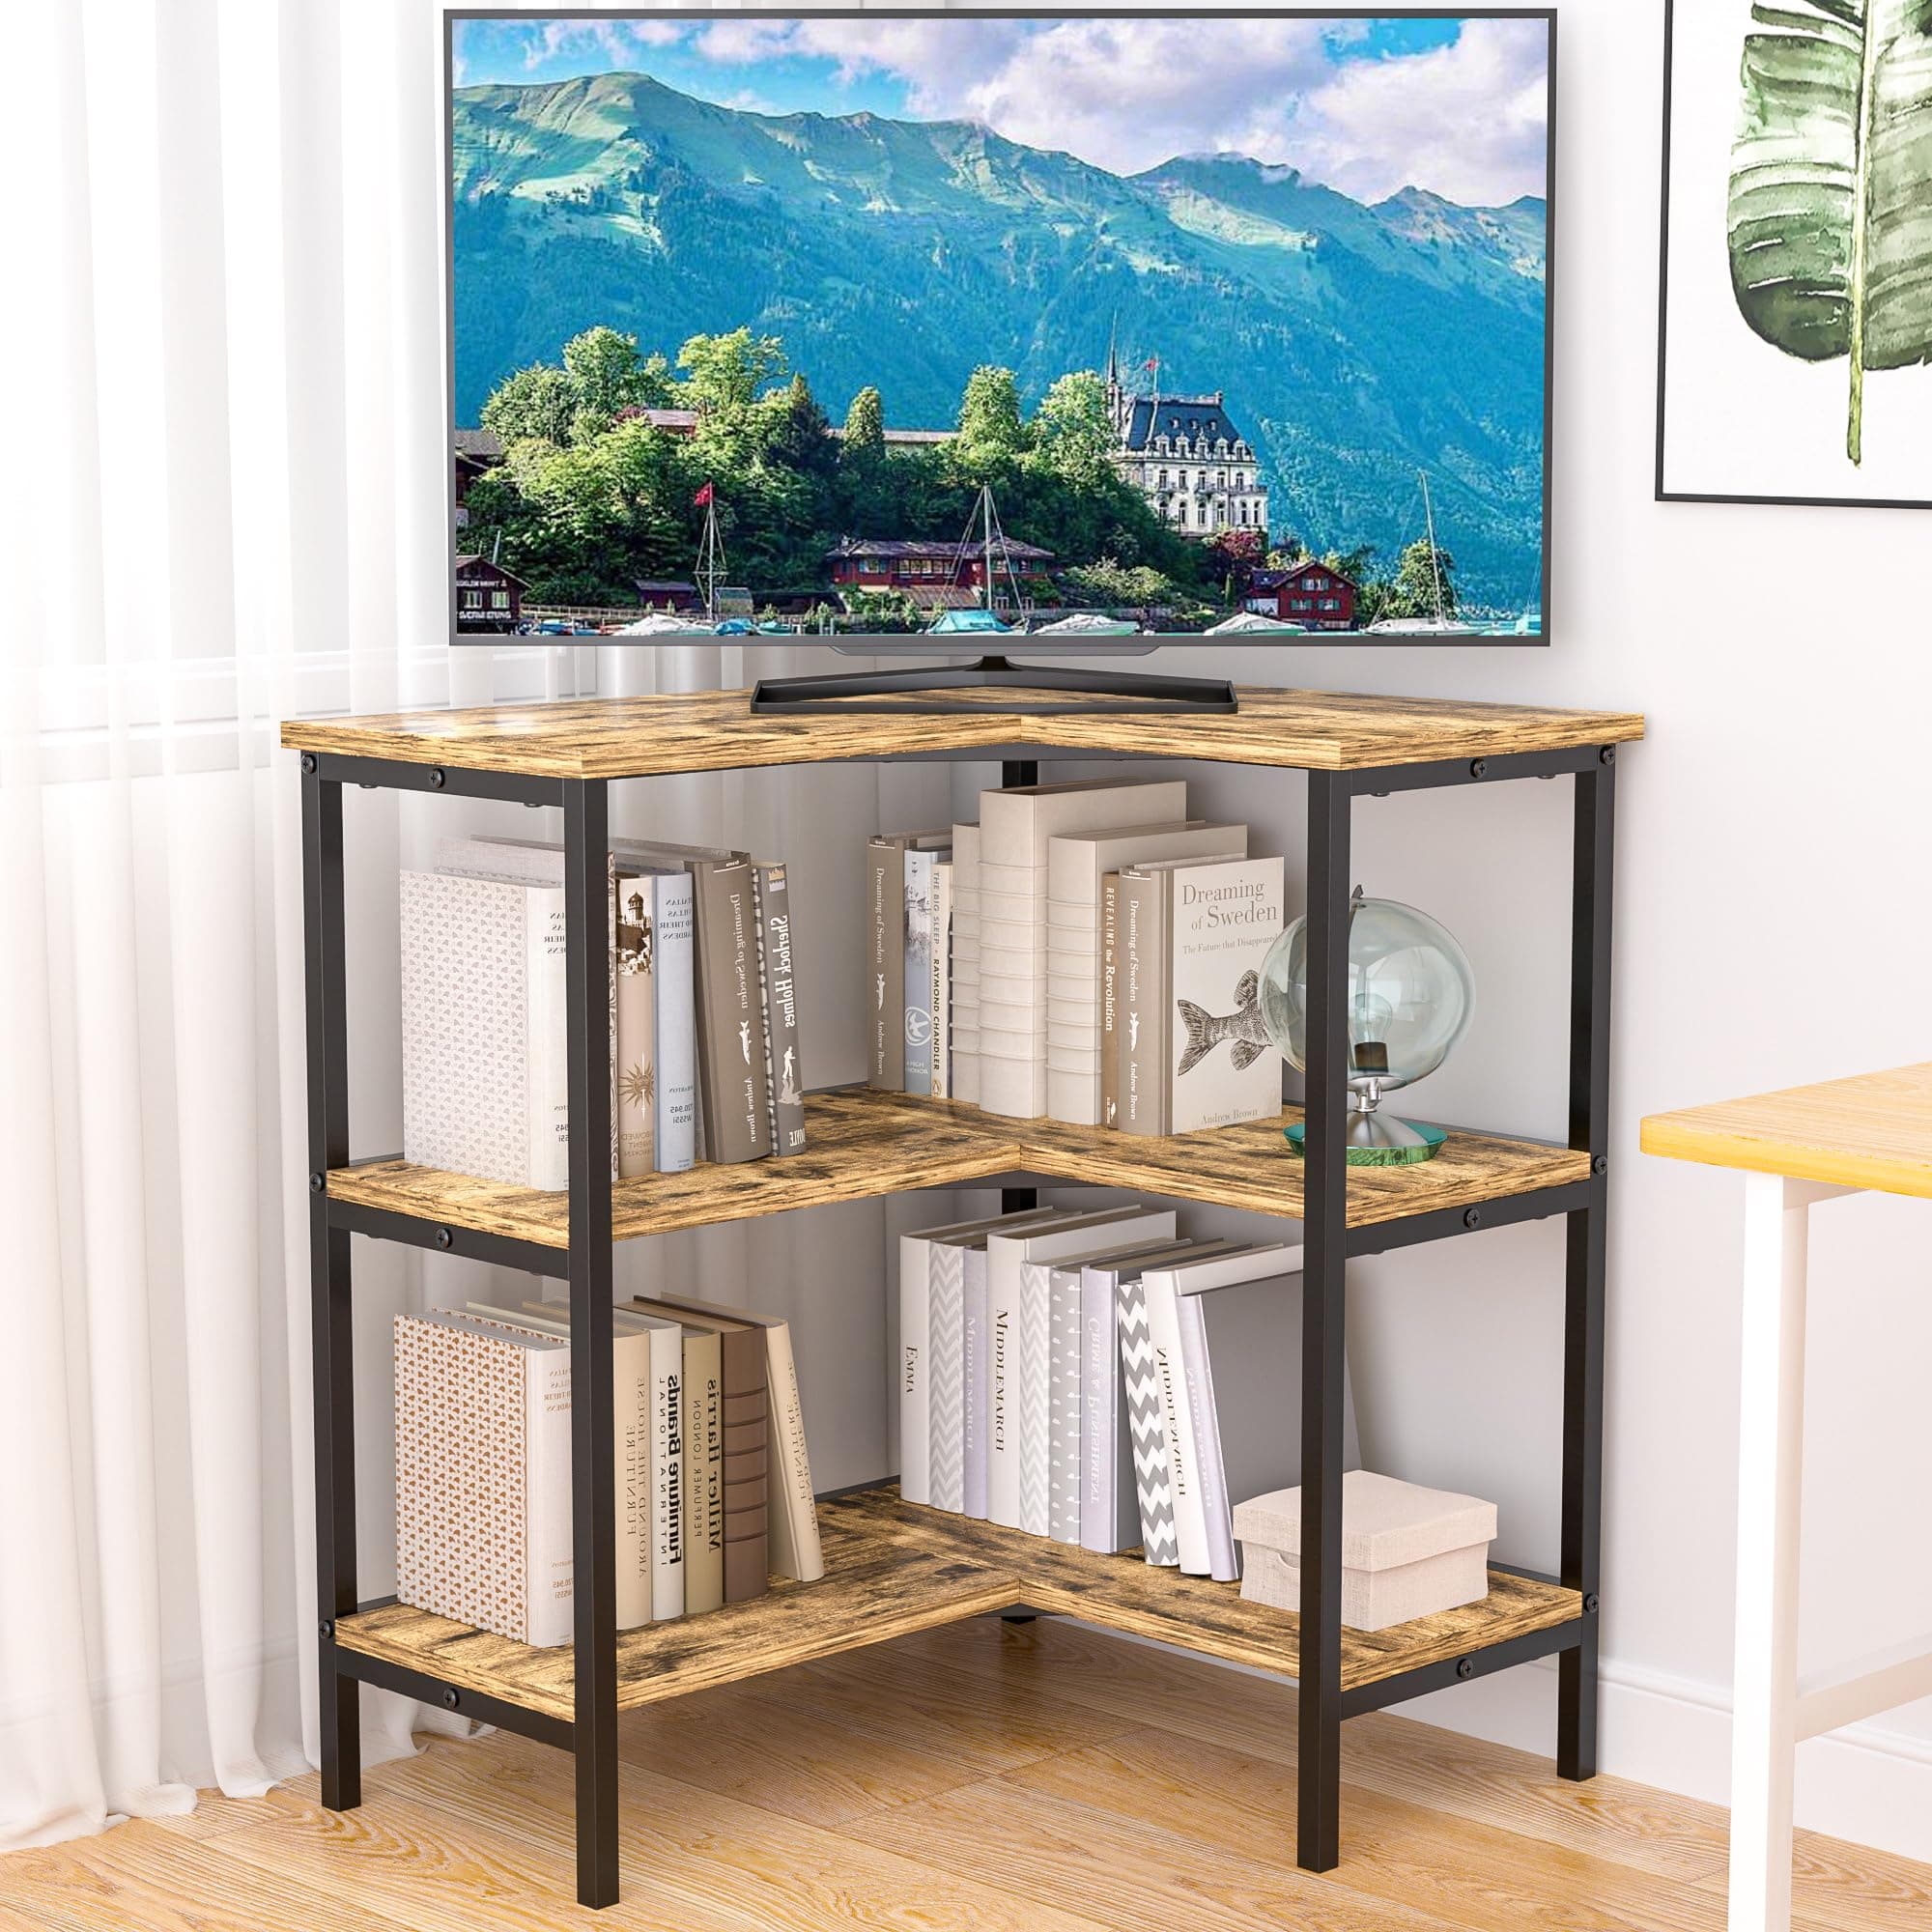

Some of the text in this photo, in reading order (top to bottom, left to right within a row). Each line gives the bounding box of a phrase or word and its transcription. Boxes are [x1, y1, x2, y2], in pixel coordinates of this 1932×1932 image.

[875, 867, 885, 964] Dreaming of Sweden
[1106, 887, 1115, 946] REVEALING
[1182, 878, 1265, 906] Dreaming
[1191, 899, 1279, 931] of Sweden
[1128, 900, 1139, 1002] Dreaming of Sweden
[1182, 946, 1196, 955] The
[1198, 943, 1221, 952] Future
[1222, 940, 1236, 950] that
[1105, 965, 1116, 1031] Revolution
[906, 1344, 918, 1393] EMMA
[967, 1317, 976, 1450] MIDDLEMARCH
[996, 1309, 1009, 1453] MIDDLEMARCH
